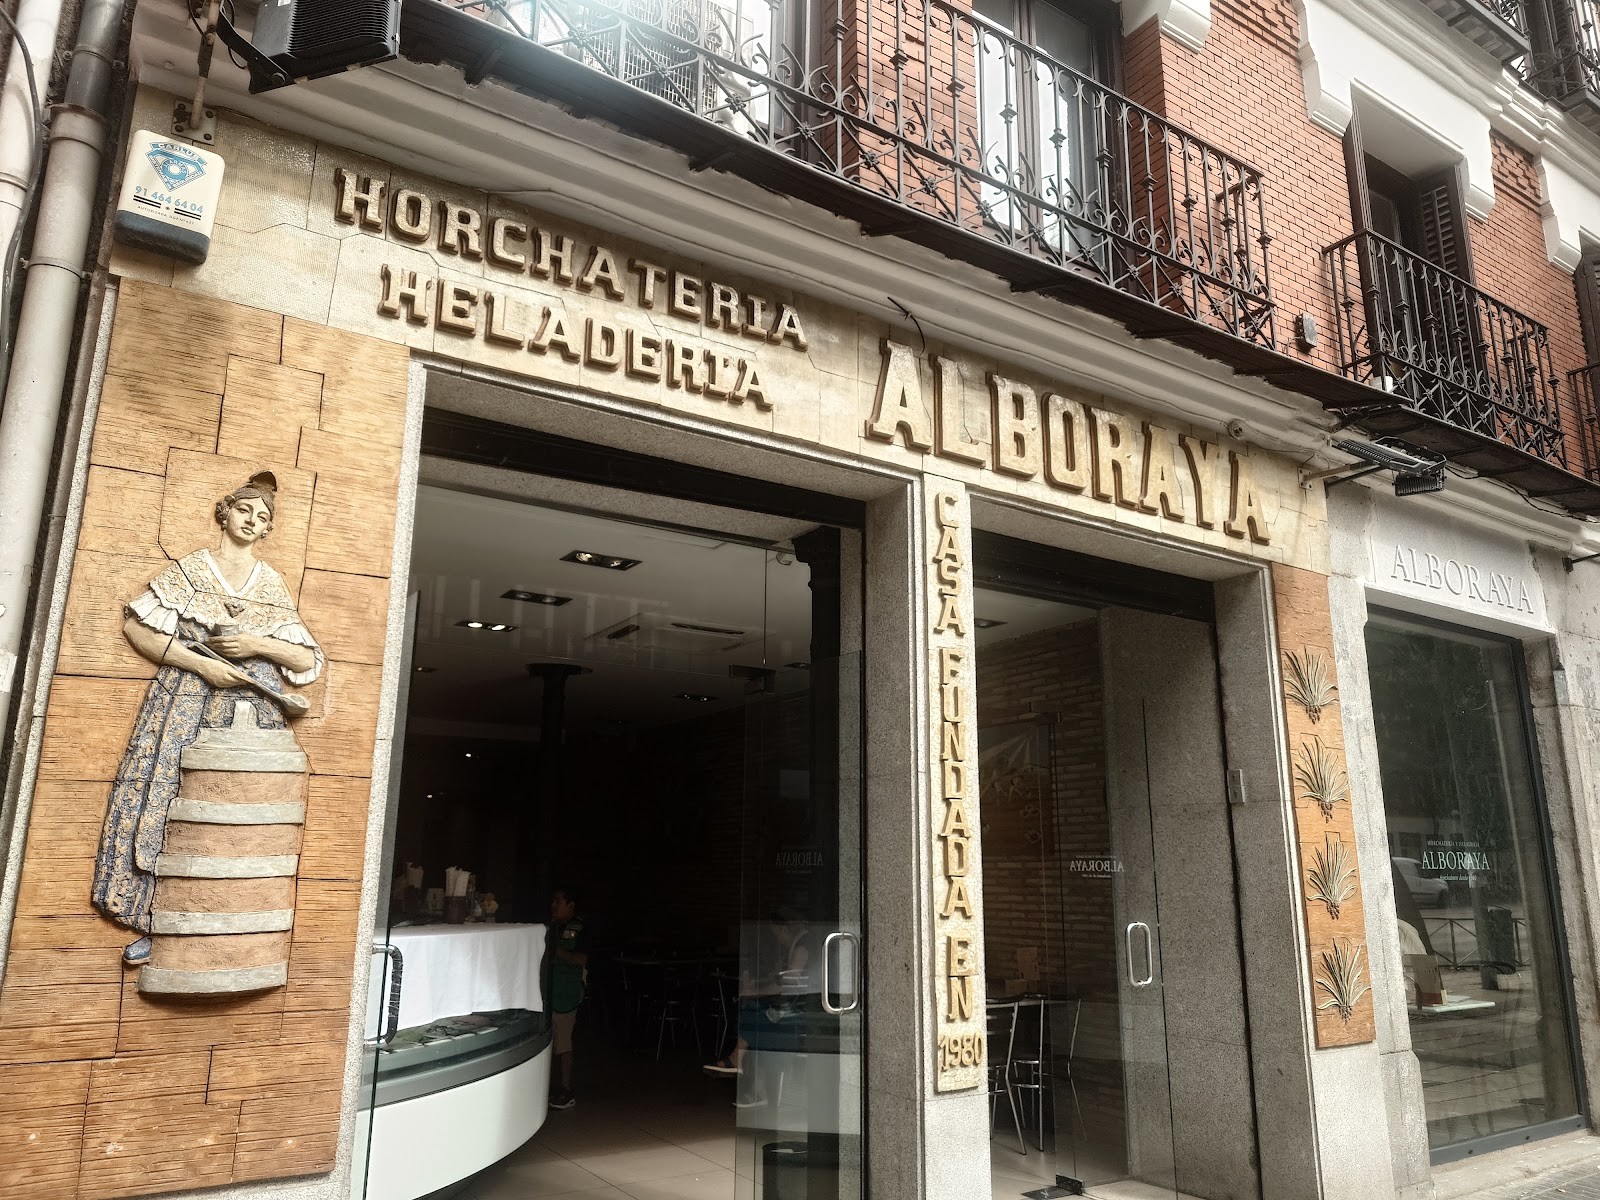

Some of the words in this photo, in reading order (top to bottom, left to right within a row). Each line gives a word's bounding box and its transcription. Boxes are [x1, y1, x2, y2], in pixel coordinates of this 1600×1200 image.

[135, 185, 148, 197] 91
[151, 191, 172, 204] 464
[174, 198, 188, 209] 64
[190, 203, 204, 214] 04
[335, 167, 808, 352] HORCHATERIA
[376, 264, 774, 411] HELADERIA
[864, 337, 1270, 545] ALBORAYA
[932, 491, 967, 637] CASA
[1391, 544, 1535, 614] ALBORAYA
[936, 648, 973, 918] FUNDADA
[1421, 851, 1490, 870] ALBORAYA
[946, 935, 980, 1023] EN
[937, 1034, 984, 1072] 1980
